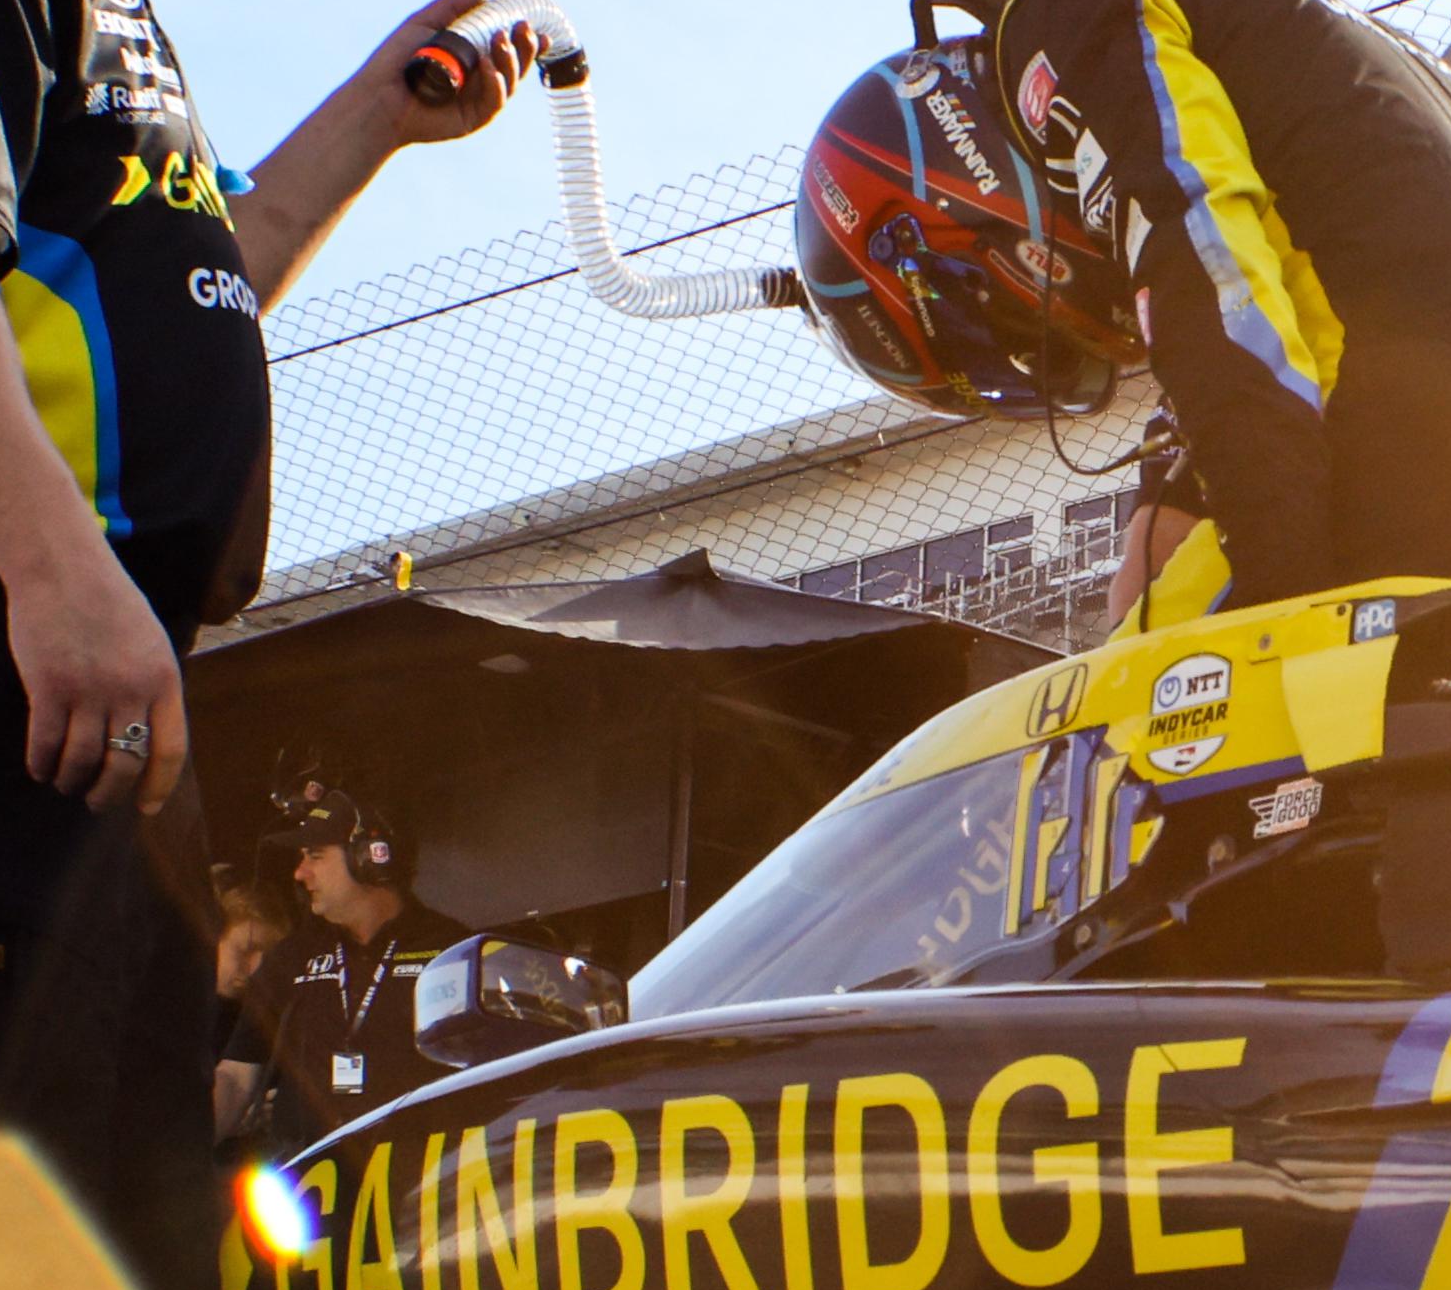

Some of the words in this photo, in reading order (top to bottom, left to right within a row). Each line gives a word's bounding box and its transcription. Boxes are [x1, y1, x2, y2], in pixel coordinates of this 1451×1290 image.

[926, 90, 1000, 195] RAINMAKER
[1356, 602, 1394, 638] PPG
[1186, 671, 1223, 696] NTT
[1149, 703, 1228, 738] INDYCAR
[1163, 726, 1209, 746] SERIES
[1276, 786, 1320, 809] FORCE
